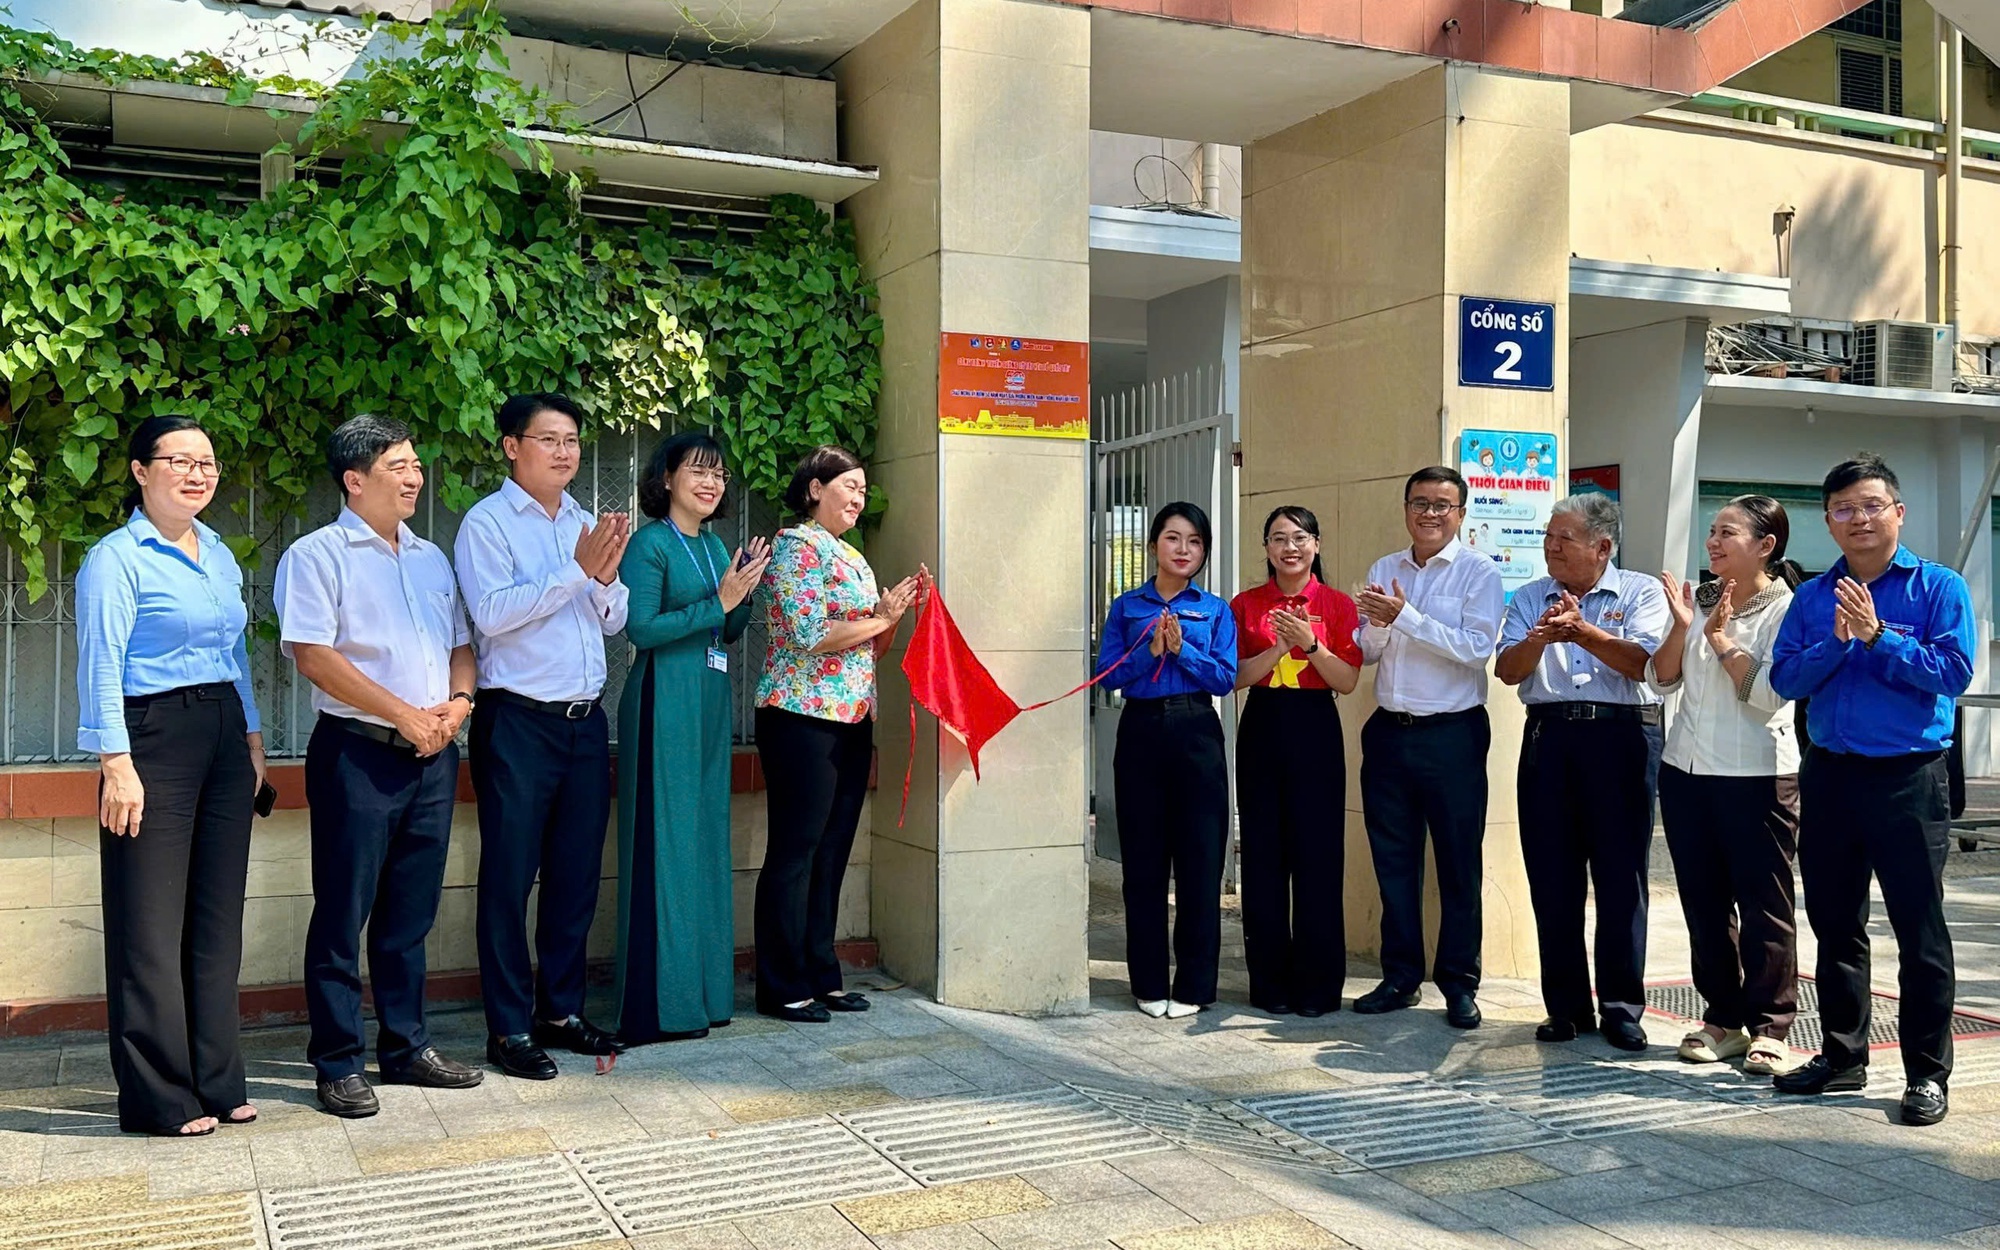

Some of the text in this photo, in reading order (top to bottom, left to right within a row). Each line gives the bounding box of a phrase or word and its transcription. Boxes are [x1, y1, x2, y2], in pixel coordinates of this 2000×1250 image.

[1470, 303, 1545, 332] CỔNG SỐ
[1493, 341, 1522, 380] 2
[1498, 478, 1523, 490] GIAN
